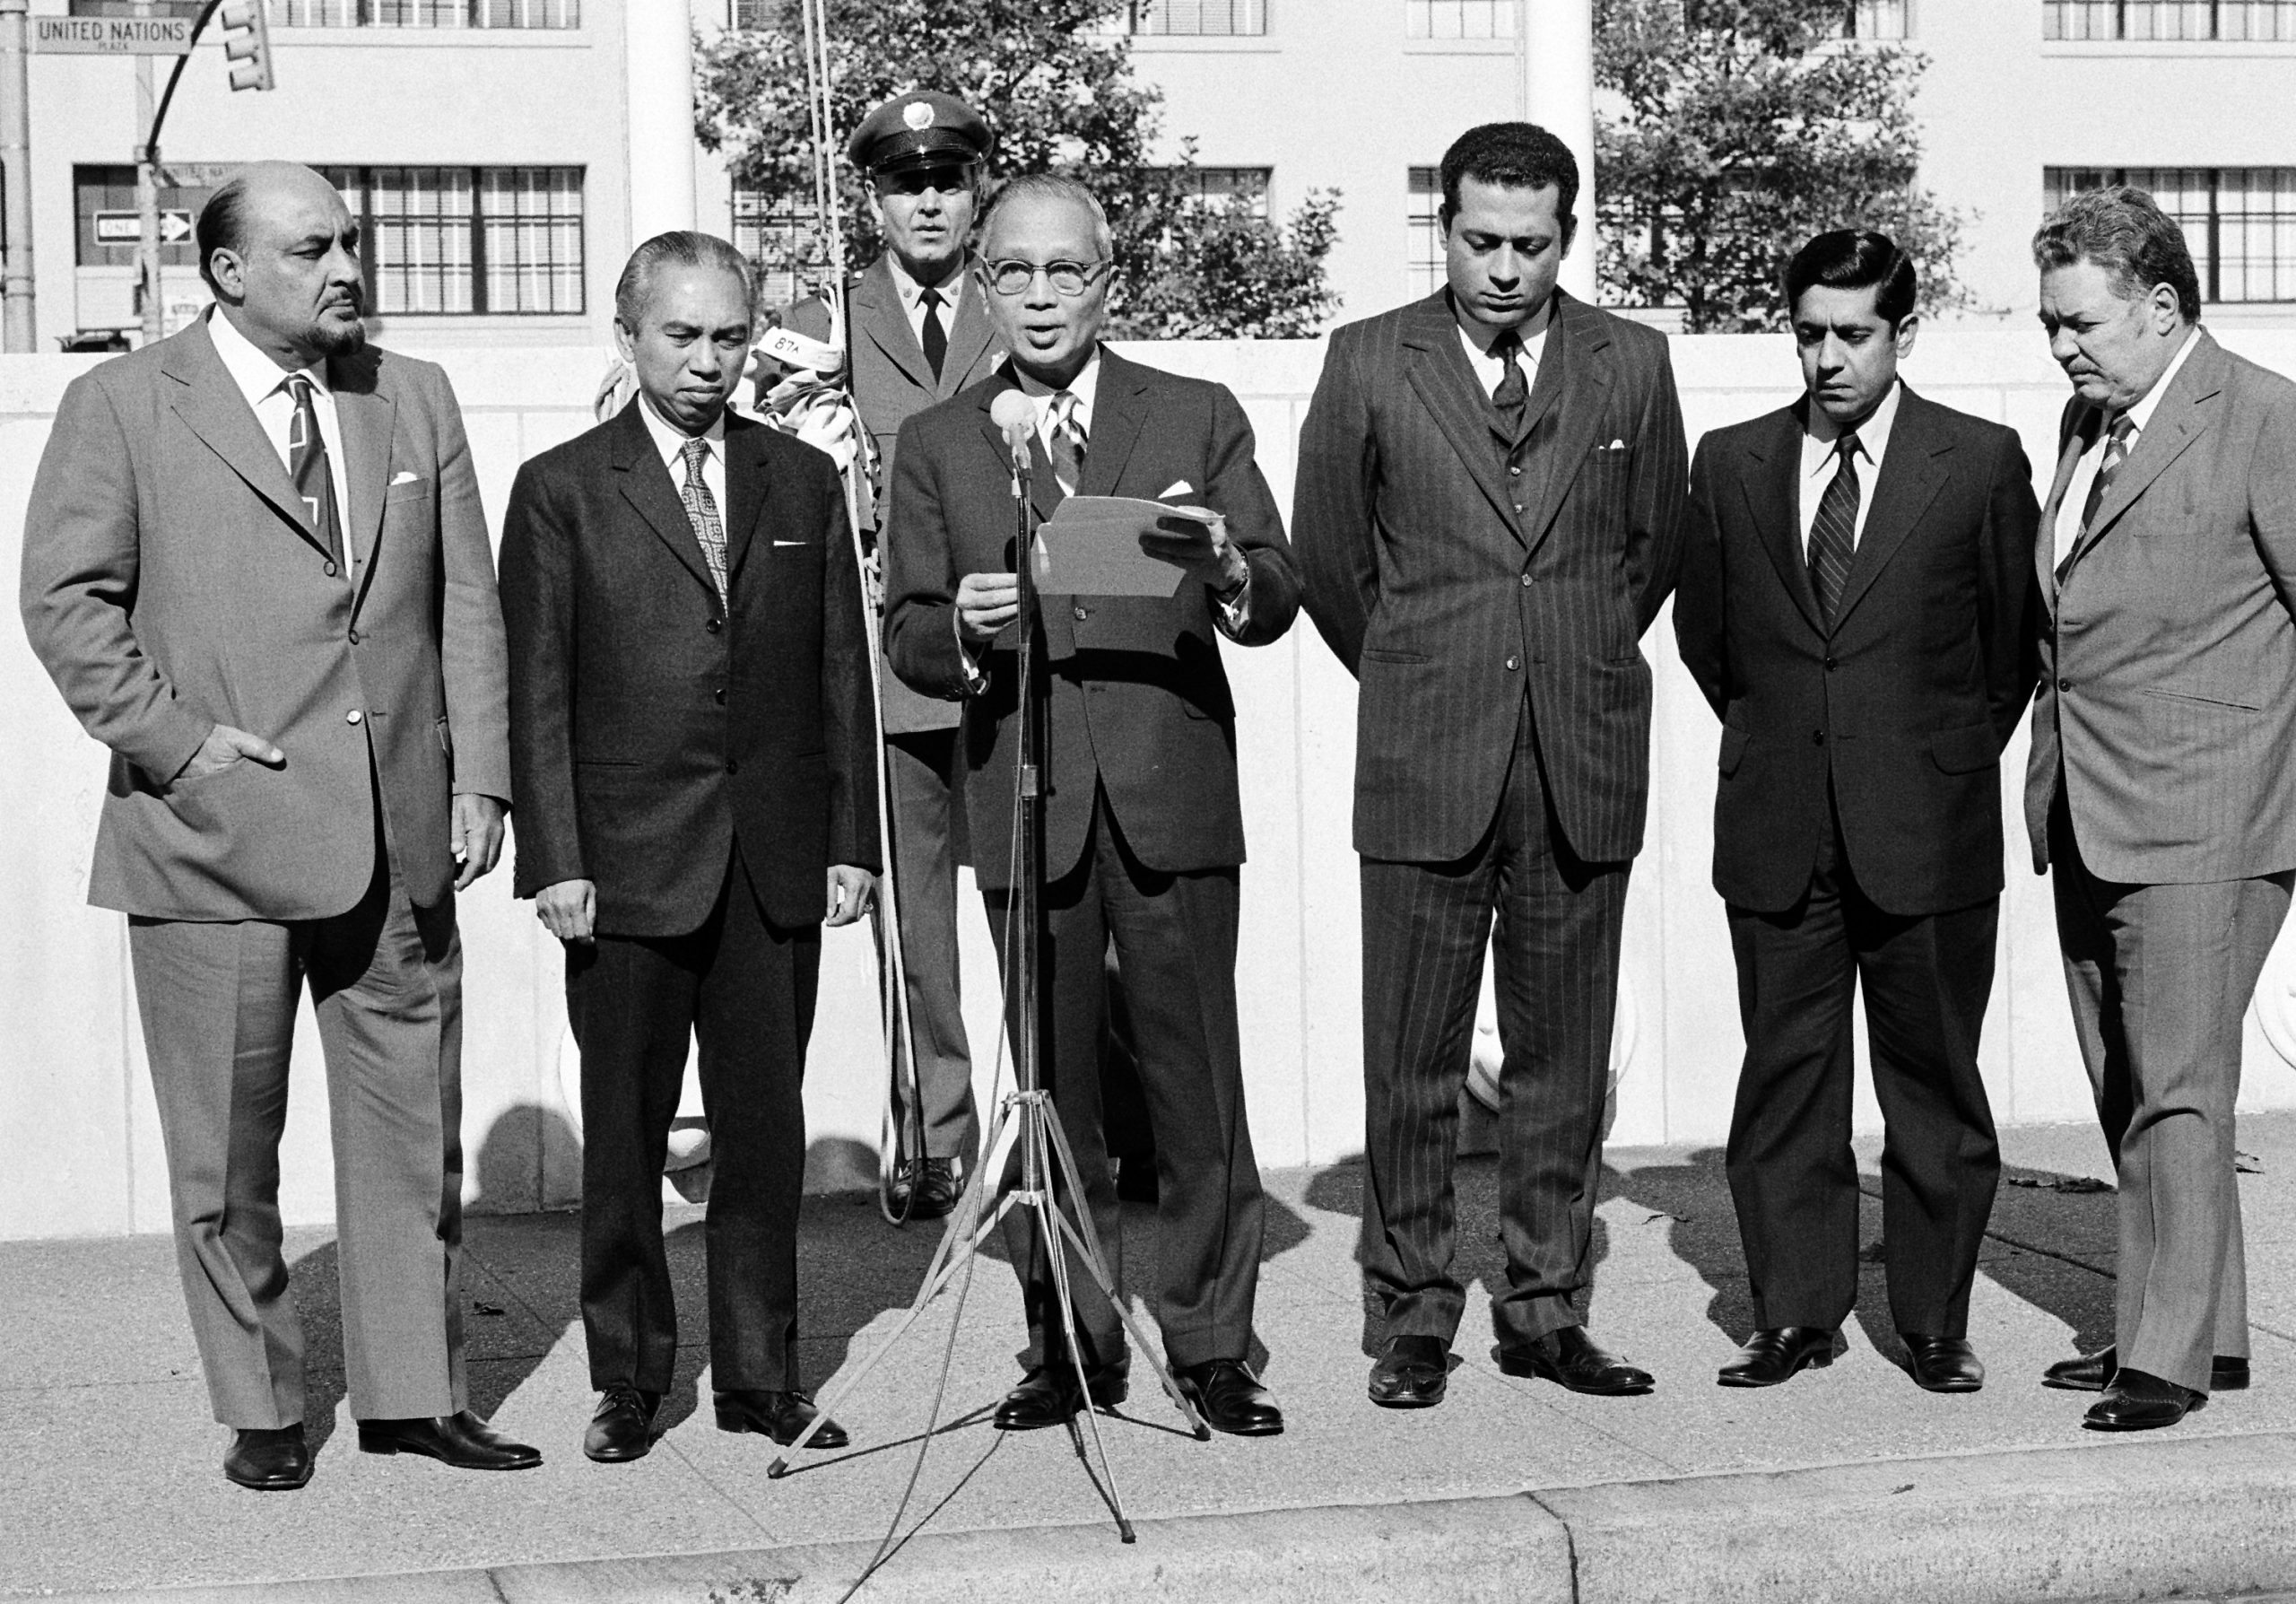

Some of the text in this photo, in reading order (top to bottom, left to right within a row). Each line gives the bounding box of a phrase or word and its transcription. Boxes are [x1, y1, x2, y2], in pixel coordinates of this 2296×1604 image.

[39, 22, 185, 41] UNITED NATIONS
[774, 337, 799, 354] 87A
